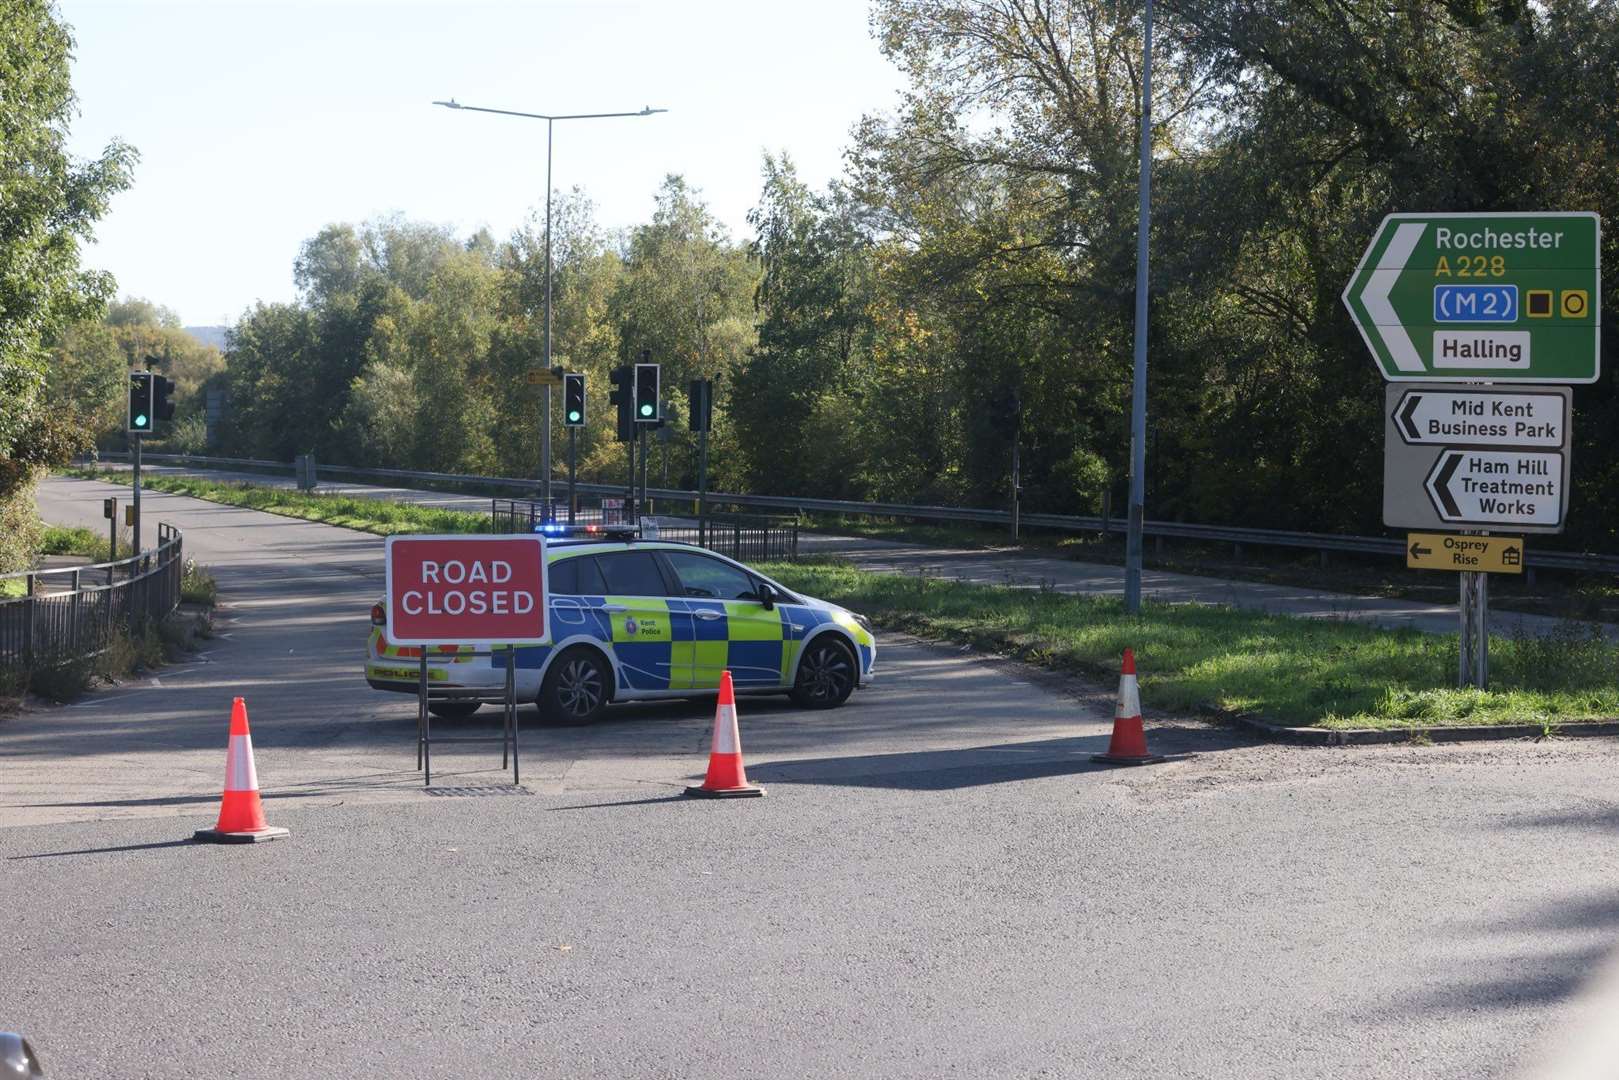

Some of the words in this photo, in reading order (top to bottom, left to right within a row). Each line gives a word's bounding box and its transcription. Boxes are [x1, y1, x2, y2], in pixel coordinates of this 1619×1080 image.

[1436, 227, 1564, 249] Rochester
[1435, 255, 1506, 277] A228
[1440, 290, 1512, 317] (M2)
[1442, 339, 1522, 362] Halling
[1451, 400, 1484, 416] Mid
[1491, 401, 1533, 417] Kent
[1428, 420, 1507, 437] Business
[1515, 422, 1556, 438] Park
[1469, 458, 1509, 475] Ham
[1517, 460, 1548, 476] Hill
[1461, 478, 1554, 496] Treatment
[1479, 498, 1536, 515] Works
[1443, 538, 1489, 553] Osprey
[1453, 554, 1478, 565] Rise
[421, 560, 512, 584] ROAD
[401, 590, 534, 615] CLOSED
